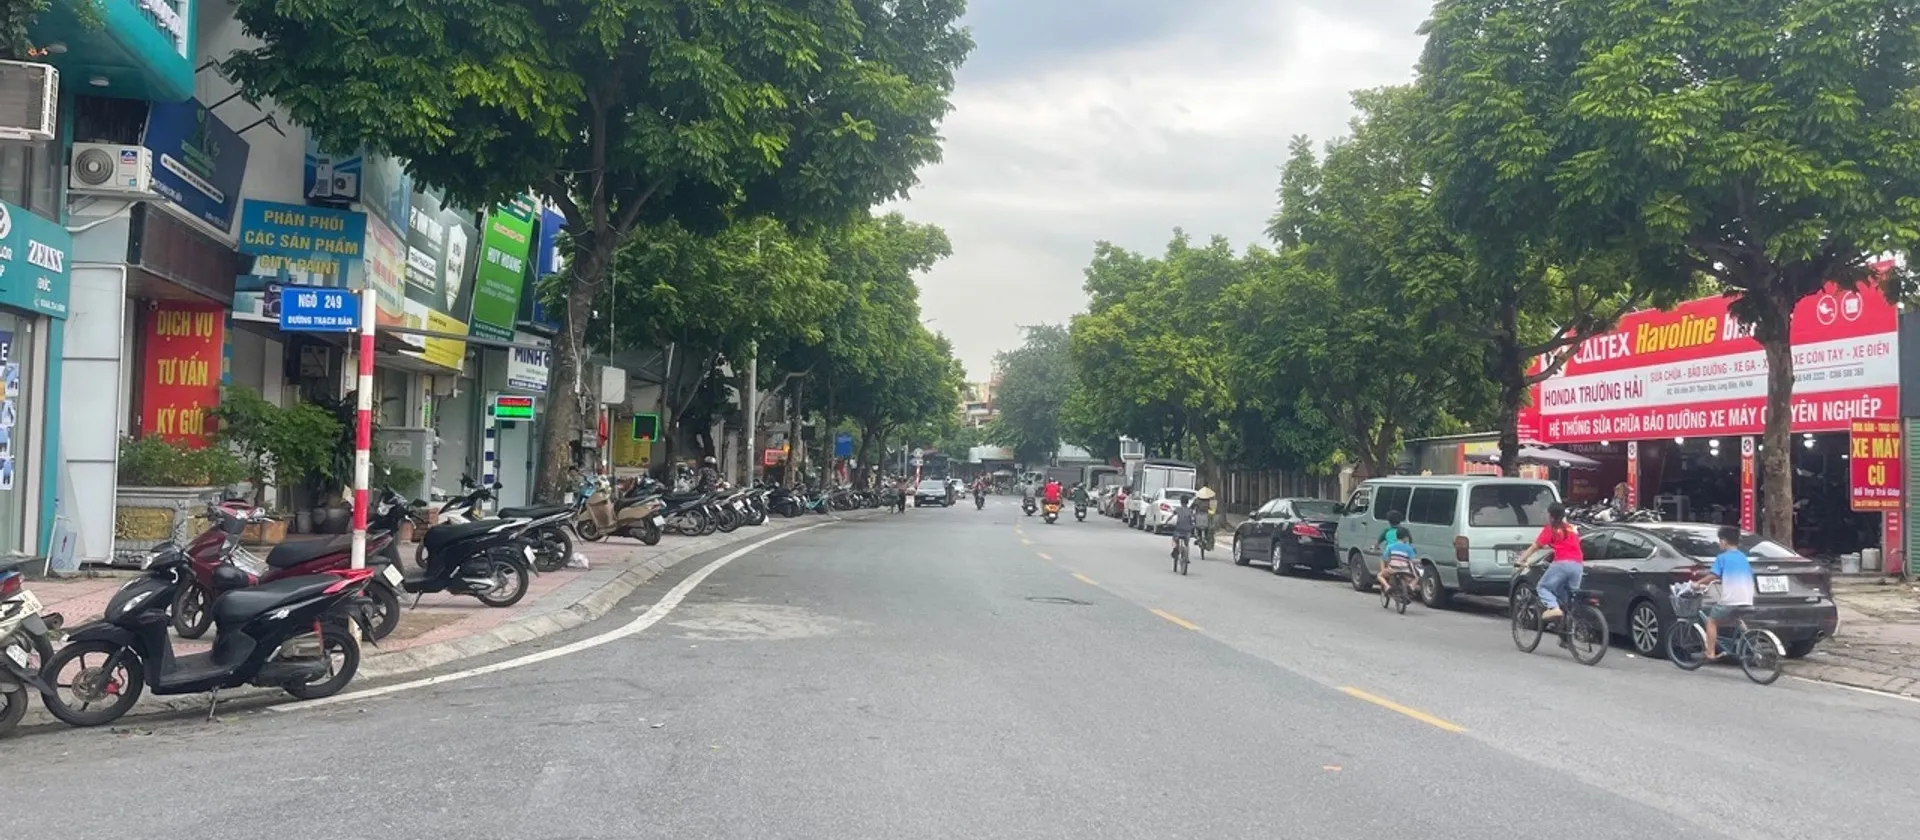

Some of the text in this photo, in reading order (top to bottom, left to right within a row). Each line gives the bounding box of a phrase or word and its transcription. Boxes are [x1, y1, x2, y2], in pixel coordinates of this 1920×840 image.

[263, 210, 345, 231] PHÂN PHỐI
[27, 239, 64, 273] ZEISS
[244, 229, 358, 255] CÁC SẢN PHẨM
[258, 254, 340, 275] CITY PAINT
[298, 291, 342, 309] NGÕ 249
[157, 310, 214, 343] DỊCH VỤ
[288, 314, 353, 327] ĐƯỜNG THẠCH BÀN
[1573, 332, 1631, 364] CALTEX
[1635, 314, 1718, 354] Havoline
[157, 351, 208, 386] TƯ VẤN
[515, 349, 542, 367] MINH
[1744, 359, 1757, 371] GA
[1793, 352, 1804, 365] XE
[1827, 348, 1844, 361] TAY
[1853, 345, 1865, 358] XE
[1867, 341, 1890, 357] ĐIỆN
[1544, 375, 1643, 407] HONDA TRƯỜNG HẢI
[157, 400, 204, 435] KÝ GỬI
[1549, 418, 1561, 439] HỆ
[1562, 415, 1591, 436] THỐNG
[1592, 414, 1613, 434] SỬA
[1614, 412, 1641, 432] CHỮA
[1642, 409, 1664, 432] BẢO
[1667, 408, 1707, 429] DƯỠNG
[1709, 410, 1726, 427] XE
[1728, 403, 1757, 426] MÁY
[1822, 394, 1882, 421] NGHIỆP
[1852, 433, 1900, 458] XE MÁY
[1868, 461, 1885, 486] CŨ
